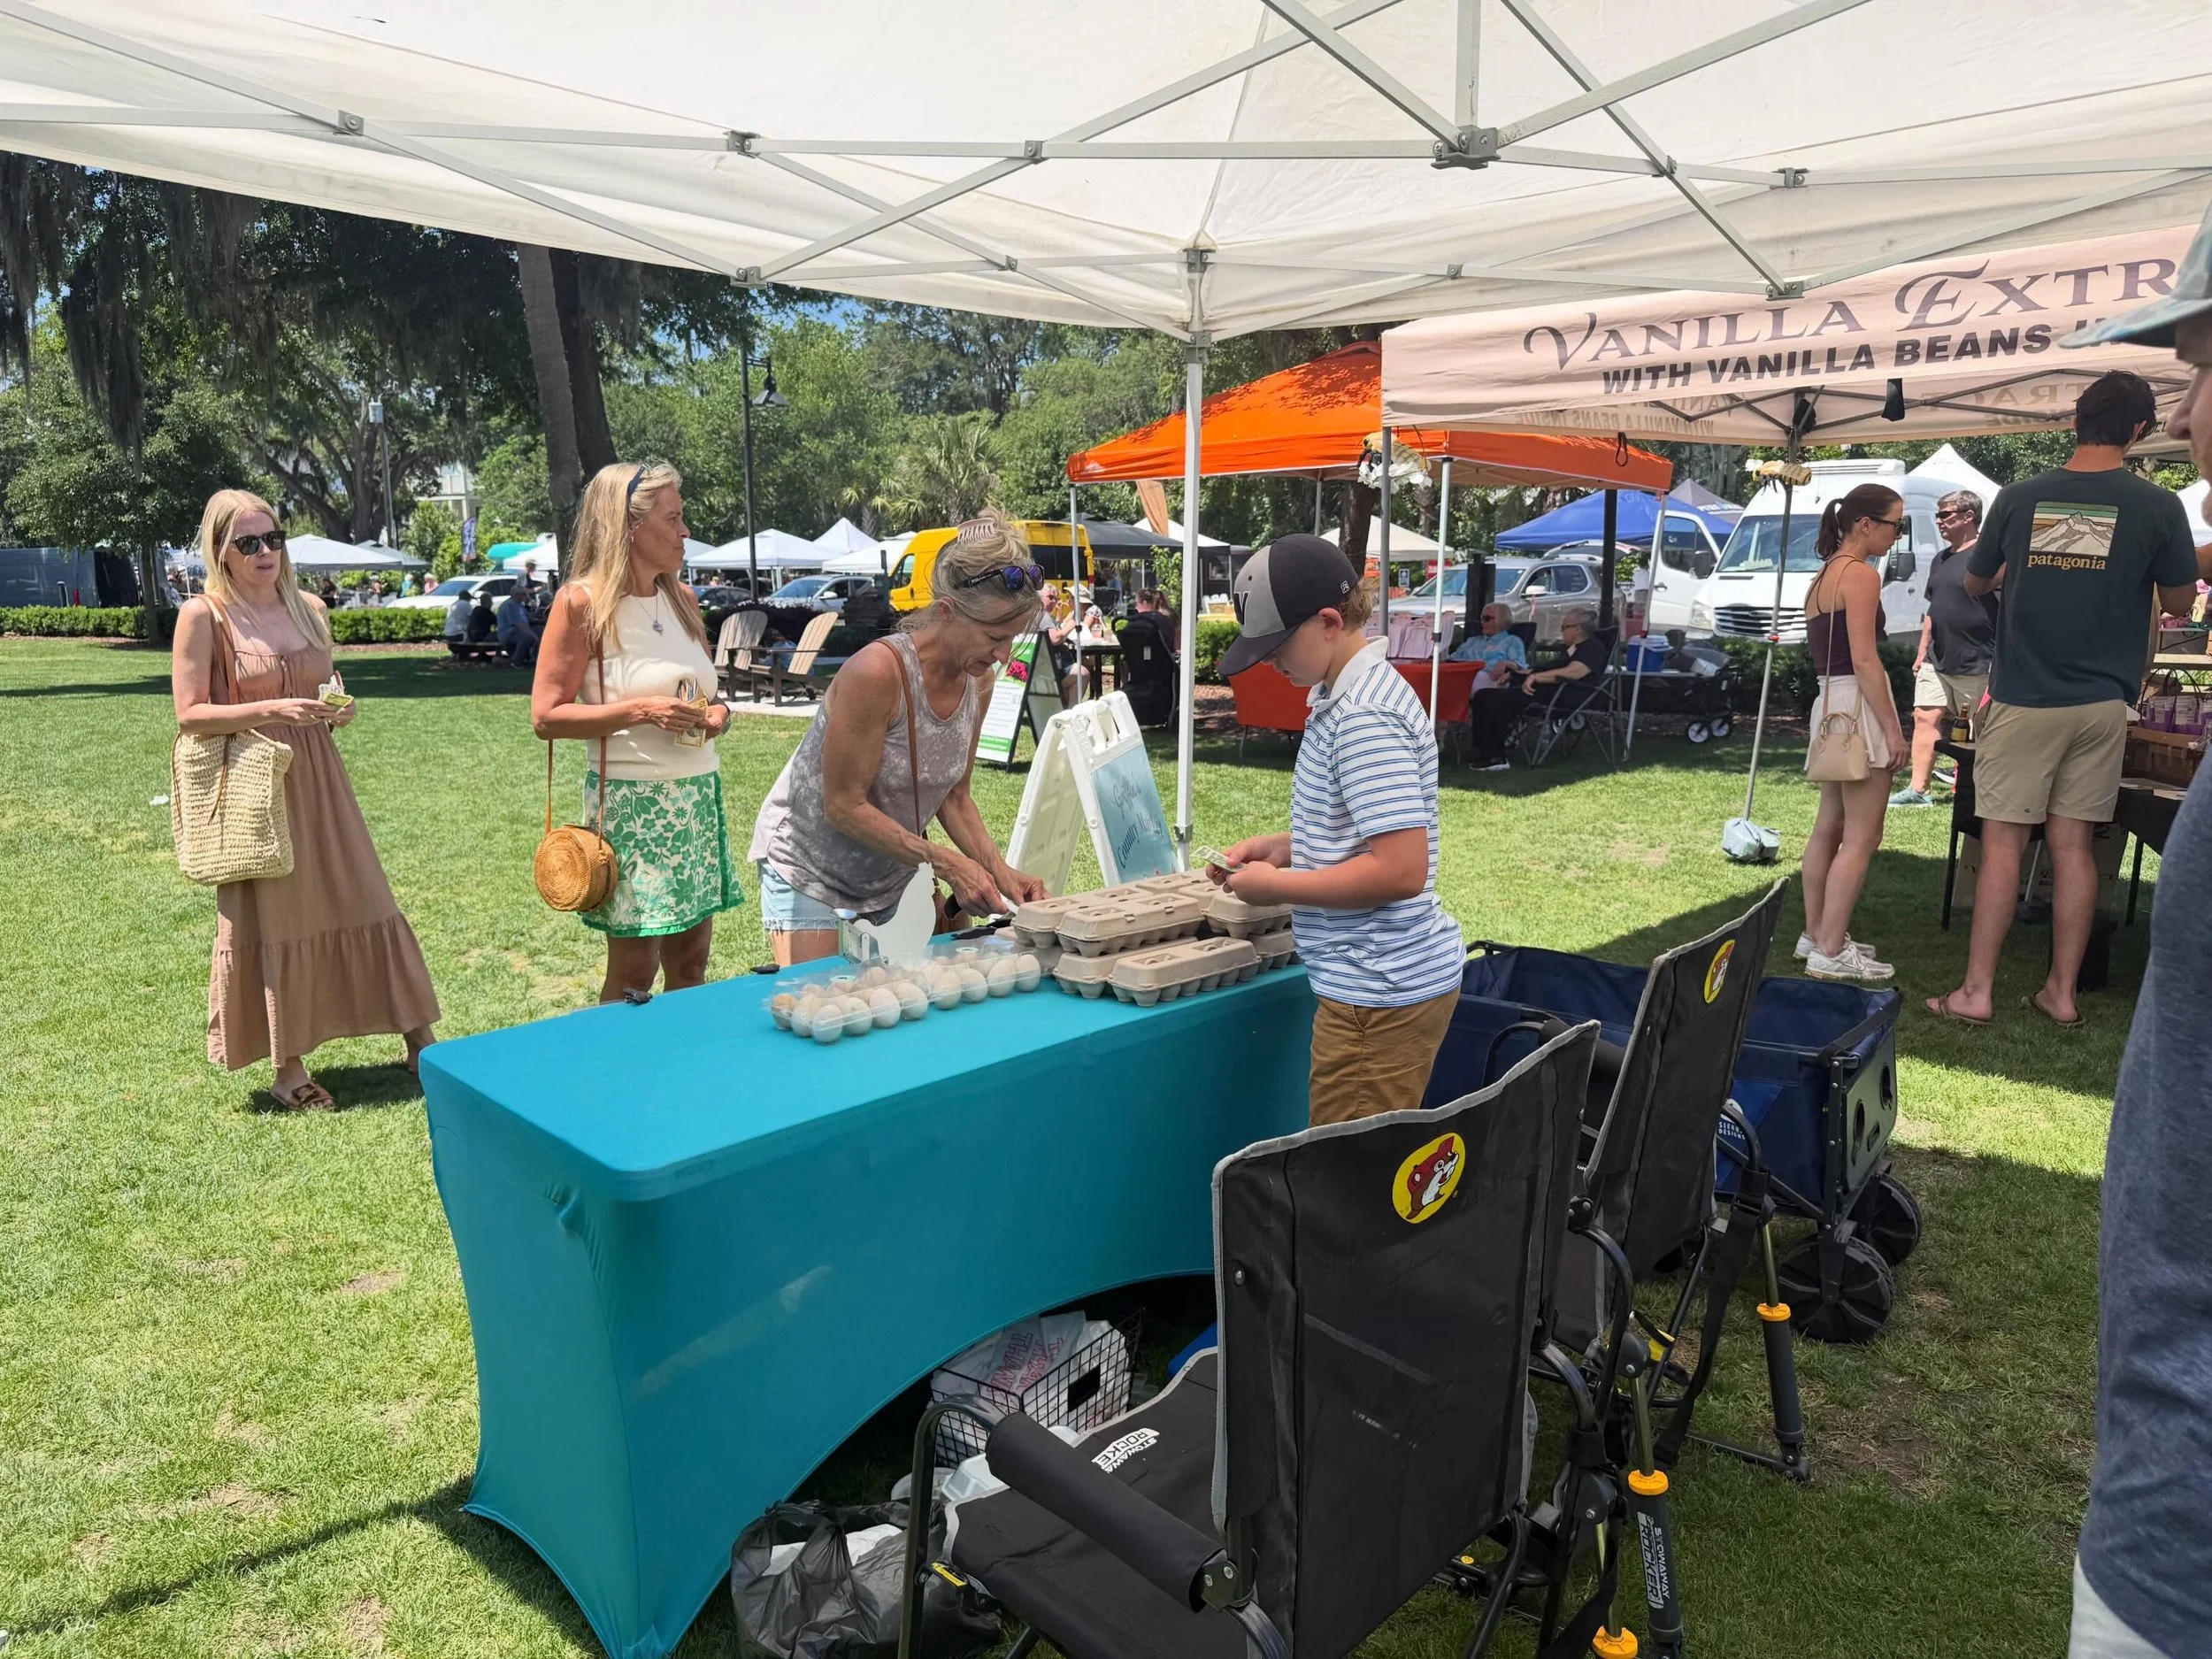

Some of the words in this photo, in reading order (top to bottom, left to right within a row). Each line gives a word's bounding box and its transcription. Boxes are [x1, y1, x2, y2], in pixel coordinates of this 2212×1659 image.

[1523, 300, 1868, 370] VANILLA
[1894, 257, 2177, 332] EXTR
[1602, 361, 1692, 395] WITH
[1707, 343, 1876, 384] VANILLA
[1893, 324, 2052, 367] BEANS
[2027, 554, 2106, 570] patagonia
[1718, 1121, 1742, 1133] SIERR
[1097, 1431, 1148, 1466] ROCKE
[1104, 1437, 1157, 1473] STOWAWA
[1640, 1522, 1661, 1599] ROCKER
[1655, 1526, 1671, 1600] STOWAWAY
